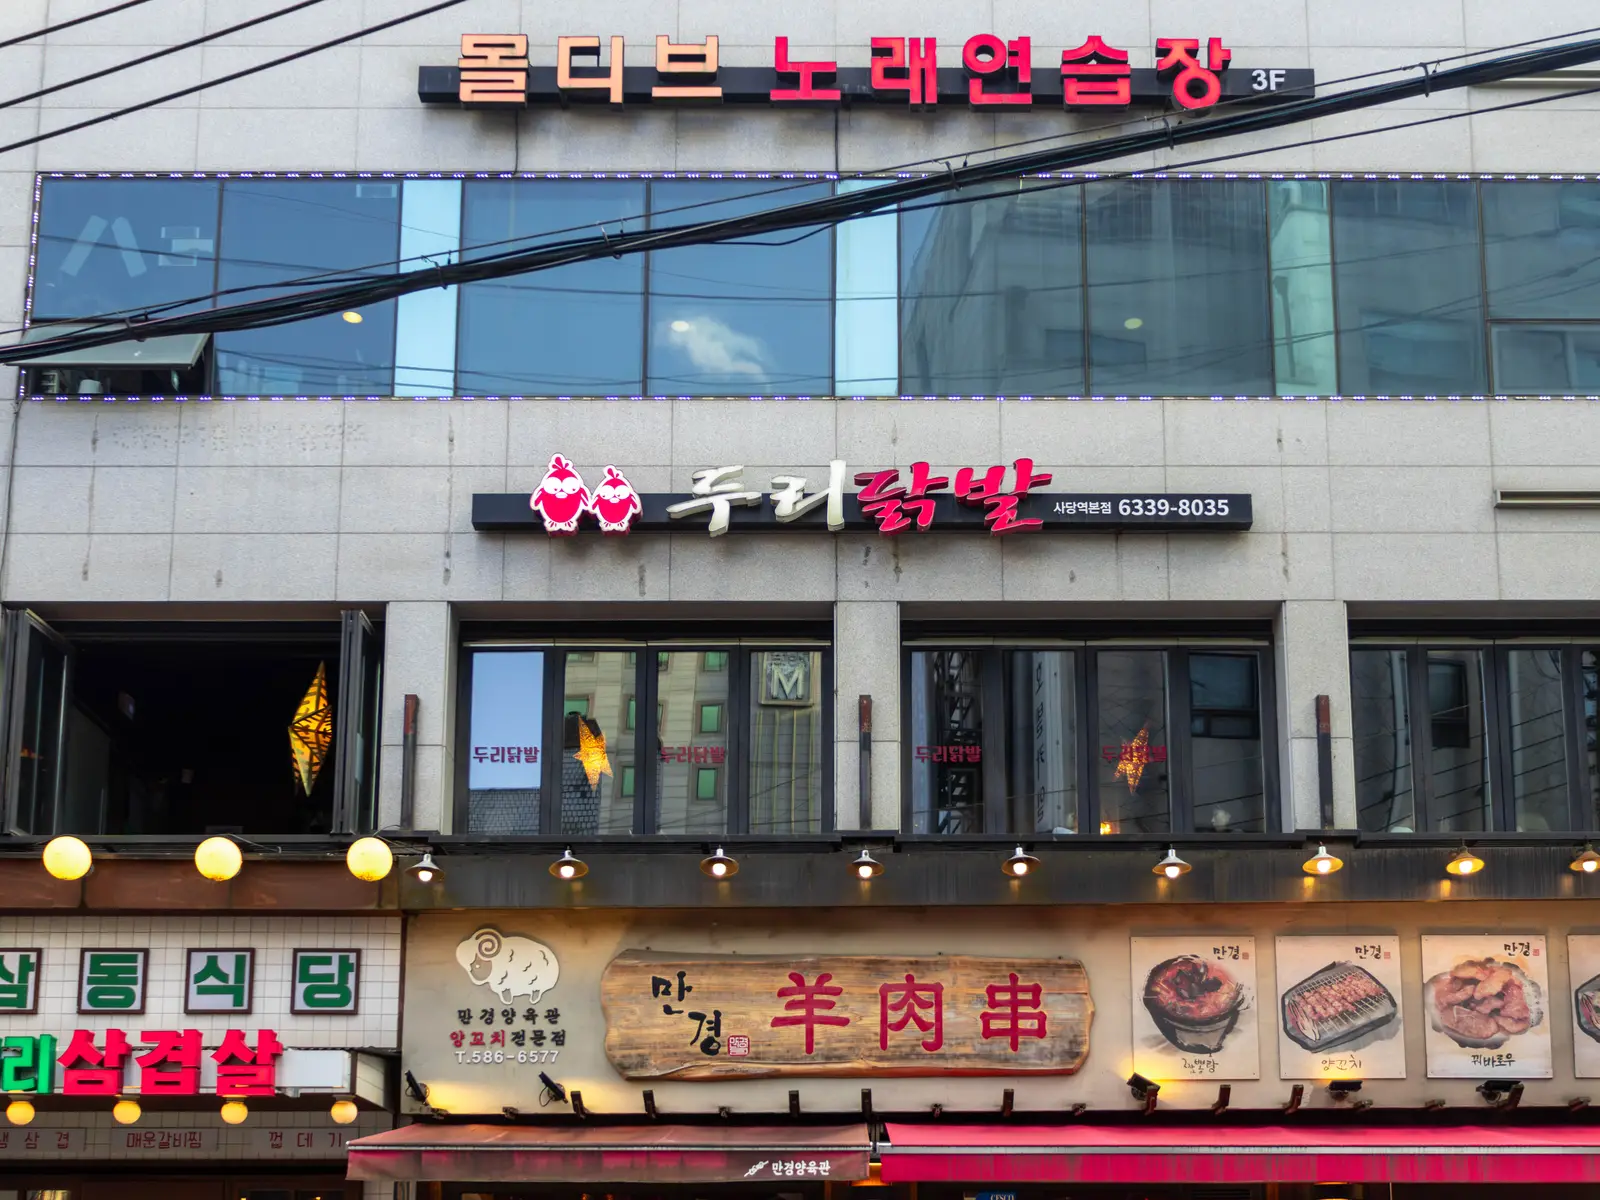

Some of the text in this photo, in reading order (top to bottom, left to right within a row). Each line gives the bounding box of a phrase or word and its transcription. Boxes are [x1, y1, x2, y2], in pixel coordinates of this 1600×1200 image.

[458, 34, 1286, 109] 몰디브 노래연습장 3F
[1053, 501, 1111, 515] 사당역본점
[1118, 498, 1229, 517] 6339-8035
[473, 745, 541, 764] 두리닭발
[914, 745, 982, 764] 두리닭발
[1213, 945, 1240, 960] 만경
[1355, 945, 1382, 959] 만경
[1504, 942, 1530, 956] 만경
[457, 1008, 561, 1025] 만경양육관
[652, 970, 723, 1057] 만경
[770, 972, 1048, 1055] 羊肉串
[455, 1050, 560, 1064] T.586-6577
[126, 1131, 202, 1149] 매운갈비찜
[771, 1159, 831, 1176] 만경양육관
